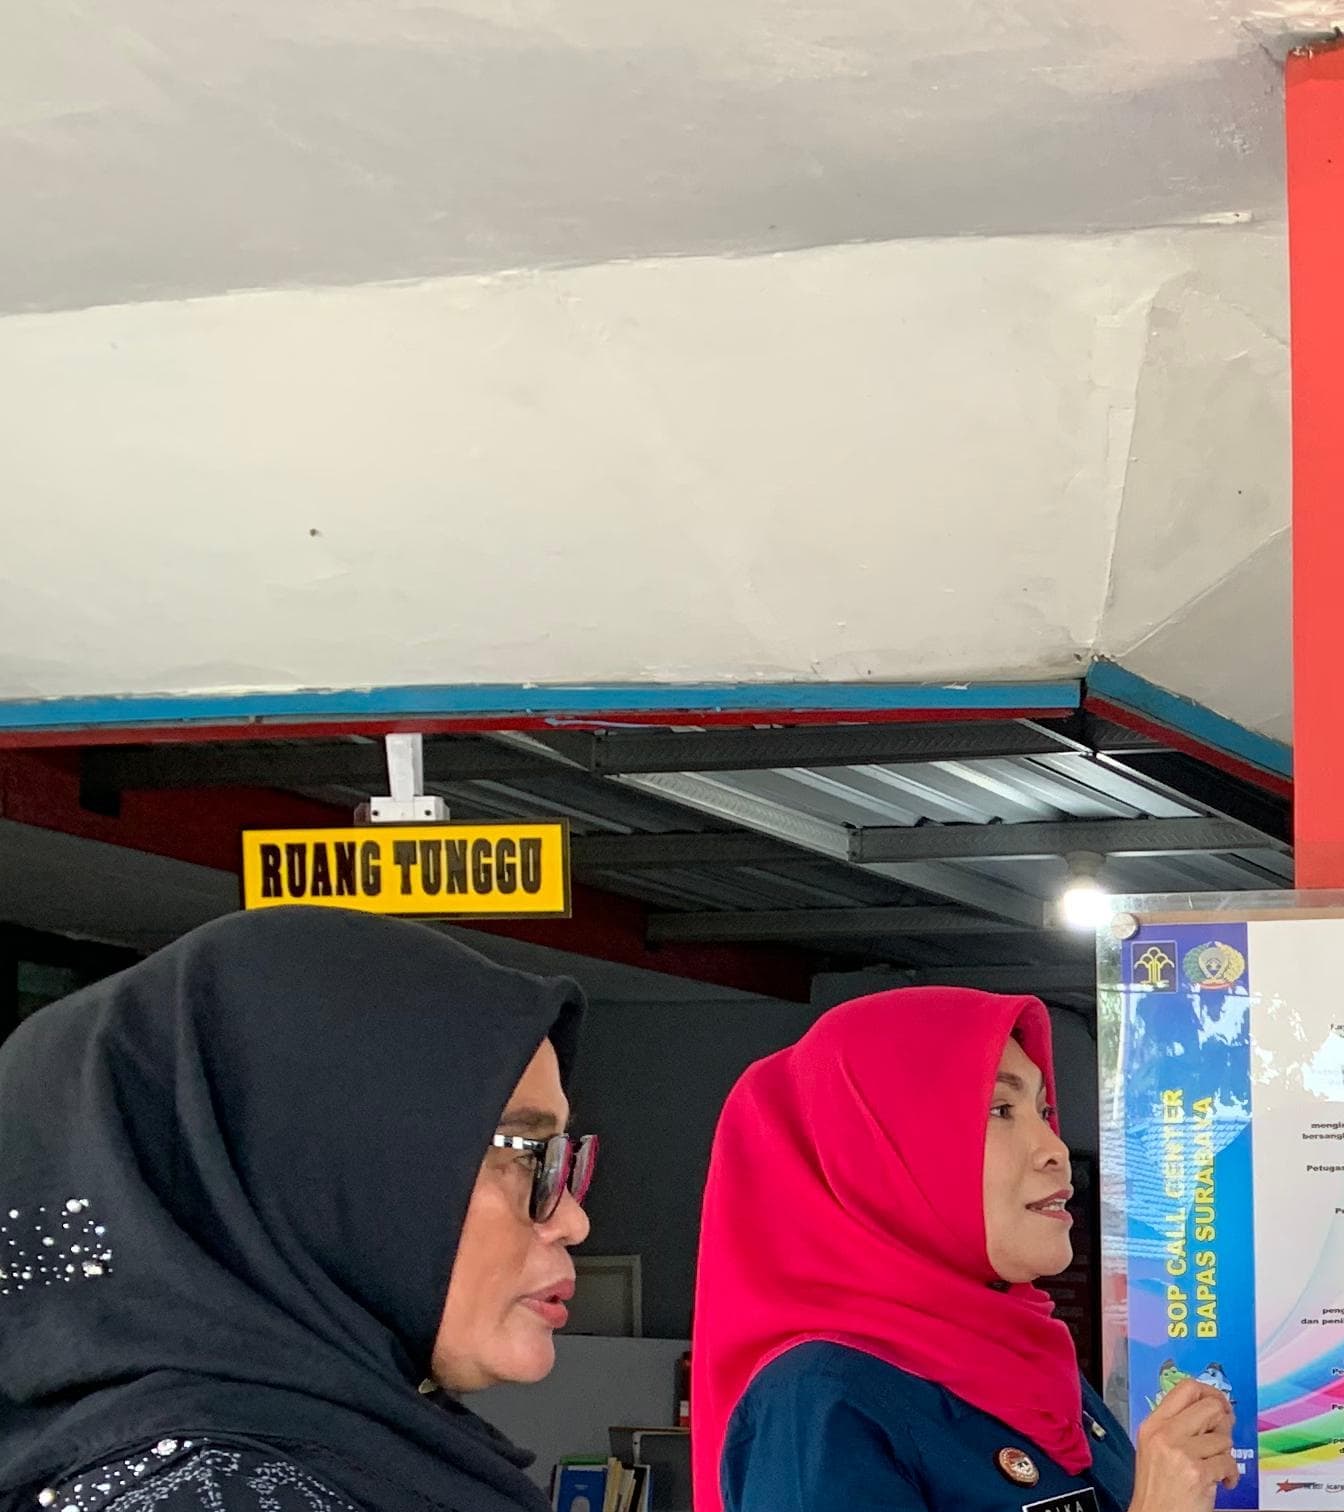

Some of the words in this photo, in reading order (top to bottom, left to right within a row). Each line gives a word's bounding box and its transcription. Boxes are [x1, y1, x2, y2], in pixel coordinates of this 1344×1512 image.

[260, 840, 381, 898] RUANG
[393, 838, 542, 895] TUNGGU
[1192, 1096, 1216, 1242] SURABAYA
[1165, 1206, 1187, 1276] CALL
[1167, 1285, 1188, 1338] SOP
[1195, 1250, 1218, 1338] BAPAS
